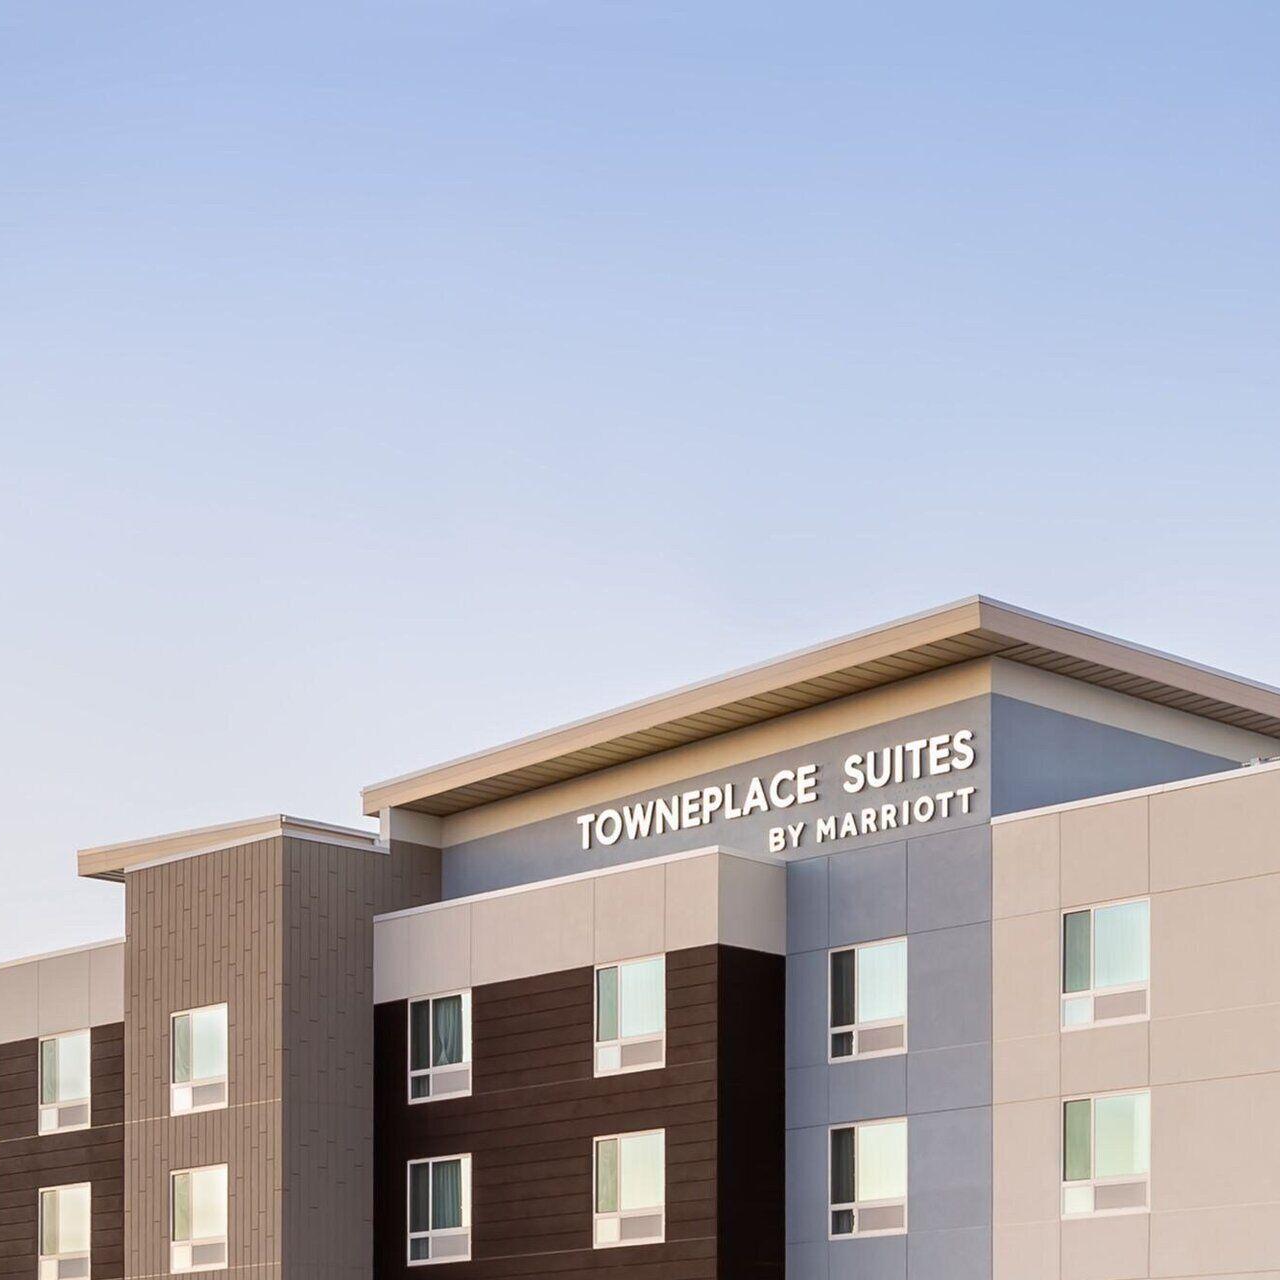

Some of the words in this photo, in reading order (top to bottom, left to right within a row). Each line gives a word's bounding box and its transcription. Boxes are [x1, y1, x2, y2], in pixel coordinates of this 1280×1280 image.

[576, 763, 818, 851] TOWNEPLACE
[842, 729, 976, 794] SUITES
[768, 821, 805, 853] BY
[816, 786, 976, 843] MARRIOTT
